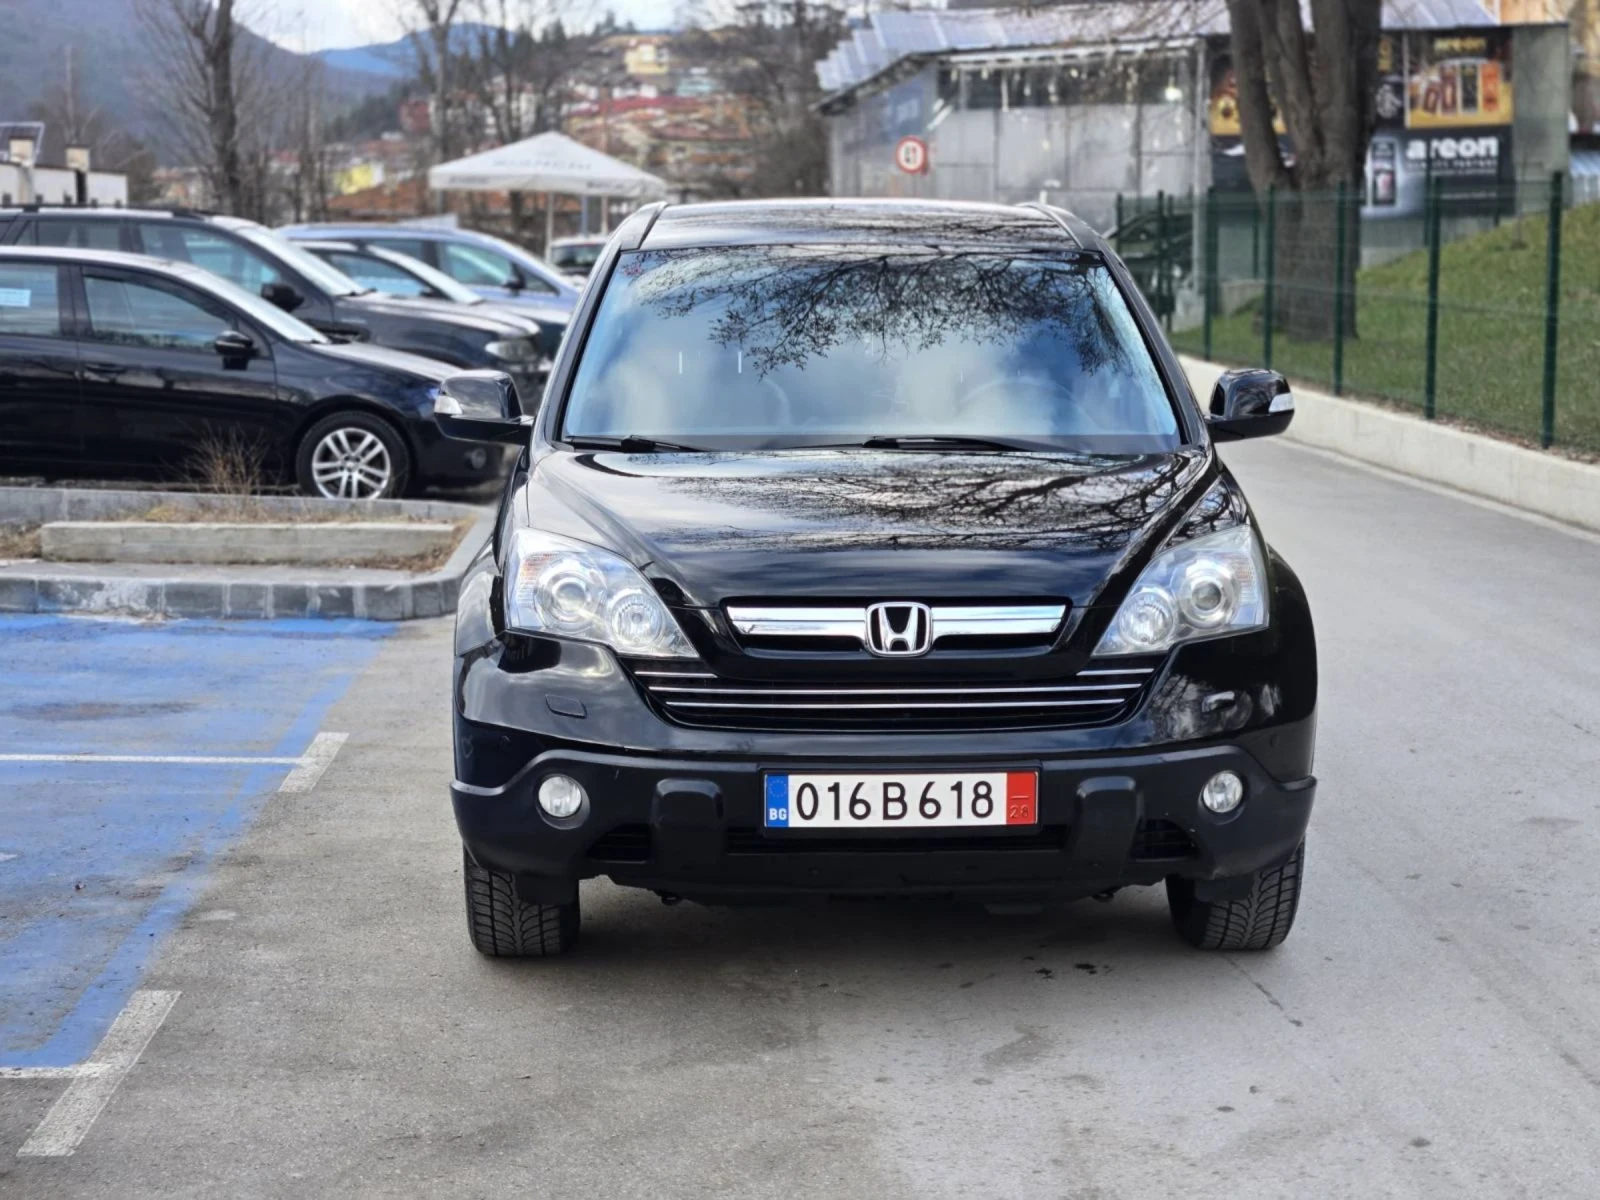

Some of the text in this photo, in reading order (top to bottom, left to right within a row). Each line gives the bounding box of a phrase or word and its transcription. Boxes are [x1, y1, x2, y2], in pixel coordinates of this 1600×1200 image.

[1405, 136, 1499, 159] areon
[796, 780, 994, 821] 016B618
[769, 808, 788, 821] BG
